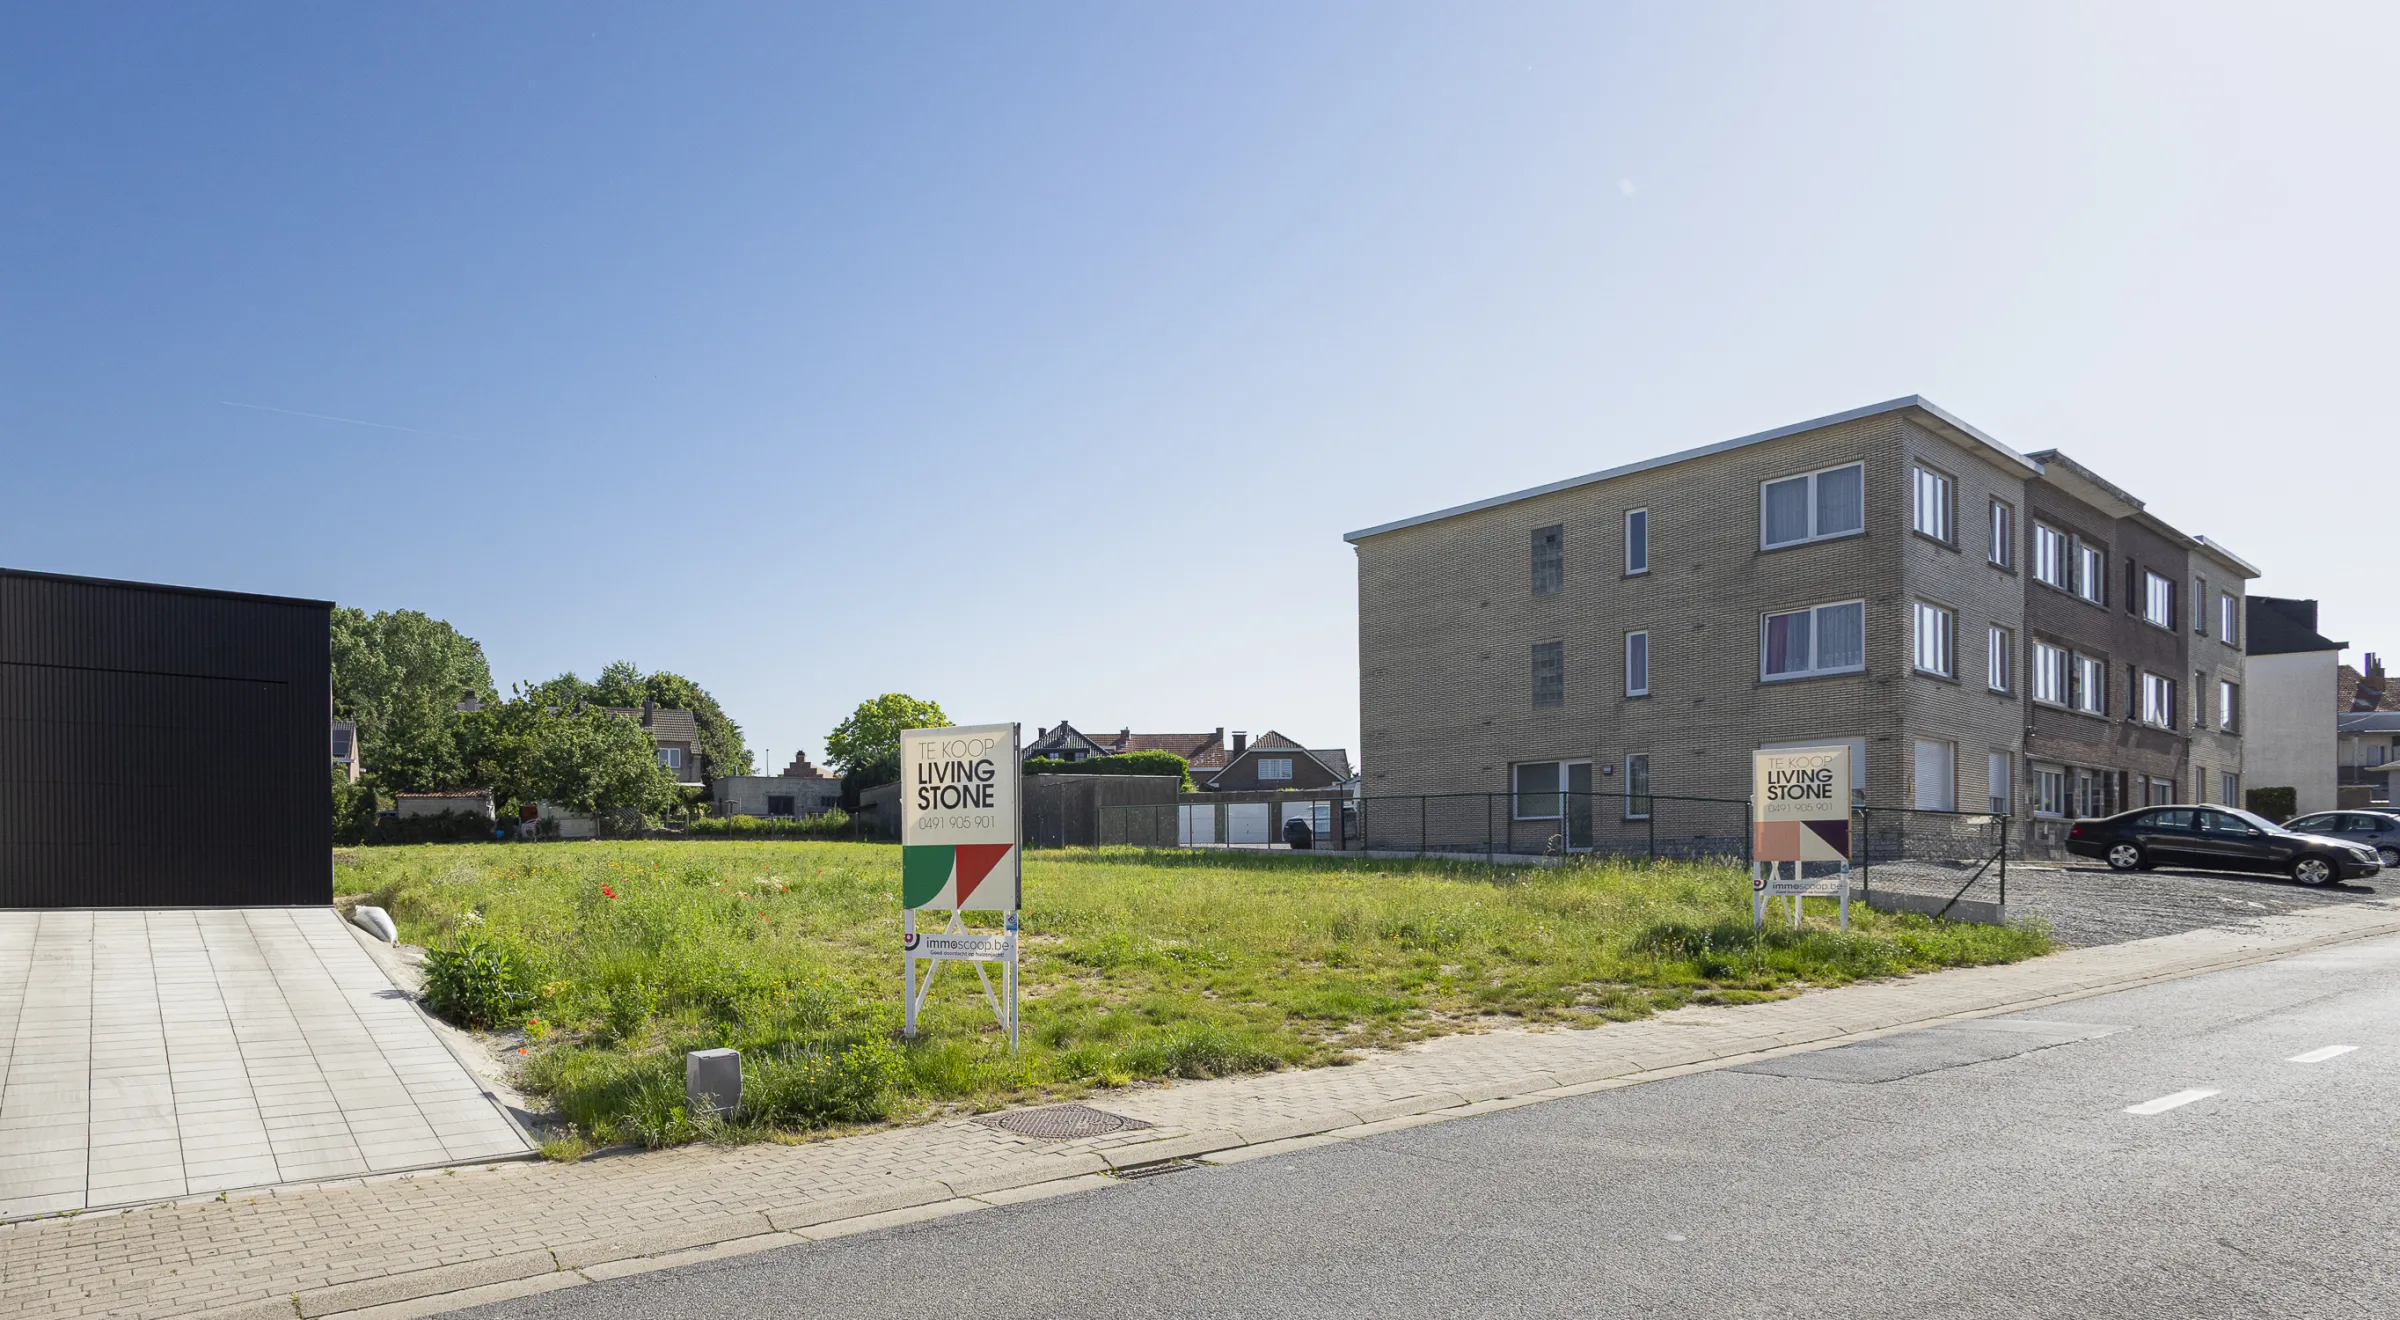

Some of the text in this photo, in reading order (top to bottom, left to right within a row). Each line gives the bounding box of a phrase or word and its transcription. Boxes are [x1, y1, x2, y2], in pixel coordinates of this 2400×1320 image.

[918, 738, 995, 760] TE KOOP
[1768, 755, 1833, 769] TE KOOP
[918, 759, 995, 785] LIVING
[1768, 768, 1833, 784] LIVING
[917, 783, 995, 811] STONE
[1767, 783, 1833, 801] STONE
[1768, 802, 1833, 813] 0491 905 901
[919, 815, 995, 830] 0491 905 901
[1772, 882, 1843, 891] immoscoop.be
[926, 937, 1009, 952] immoscoop.be
